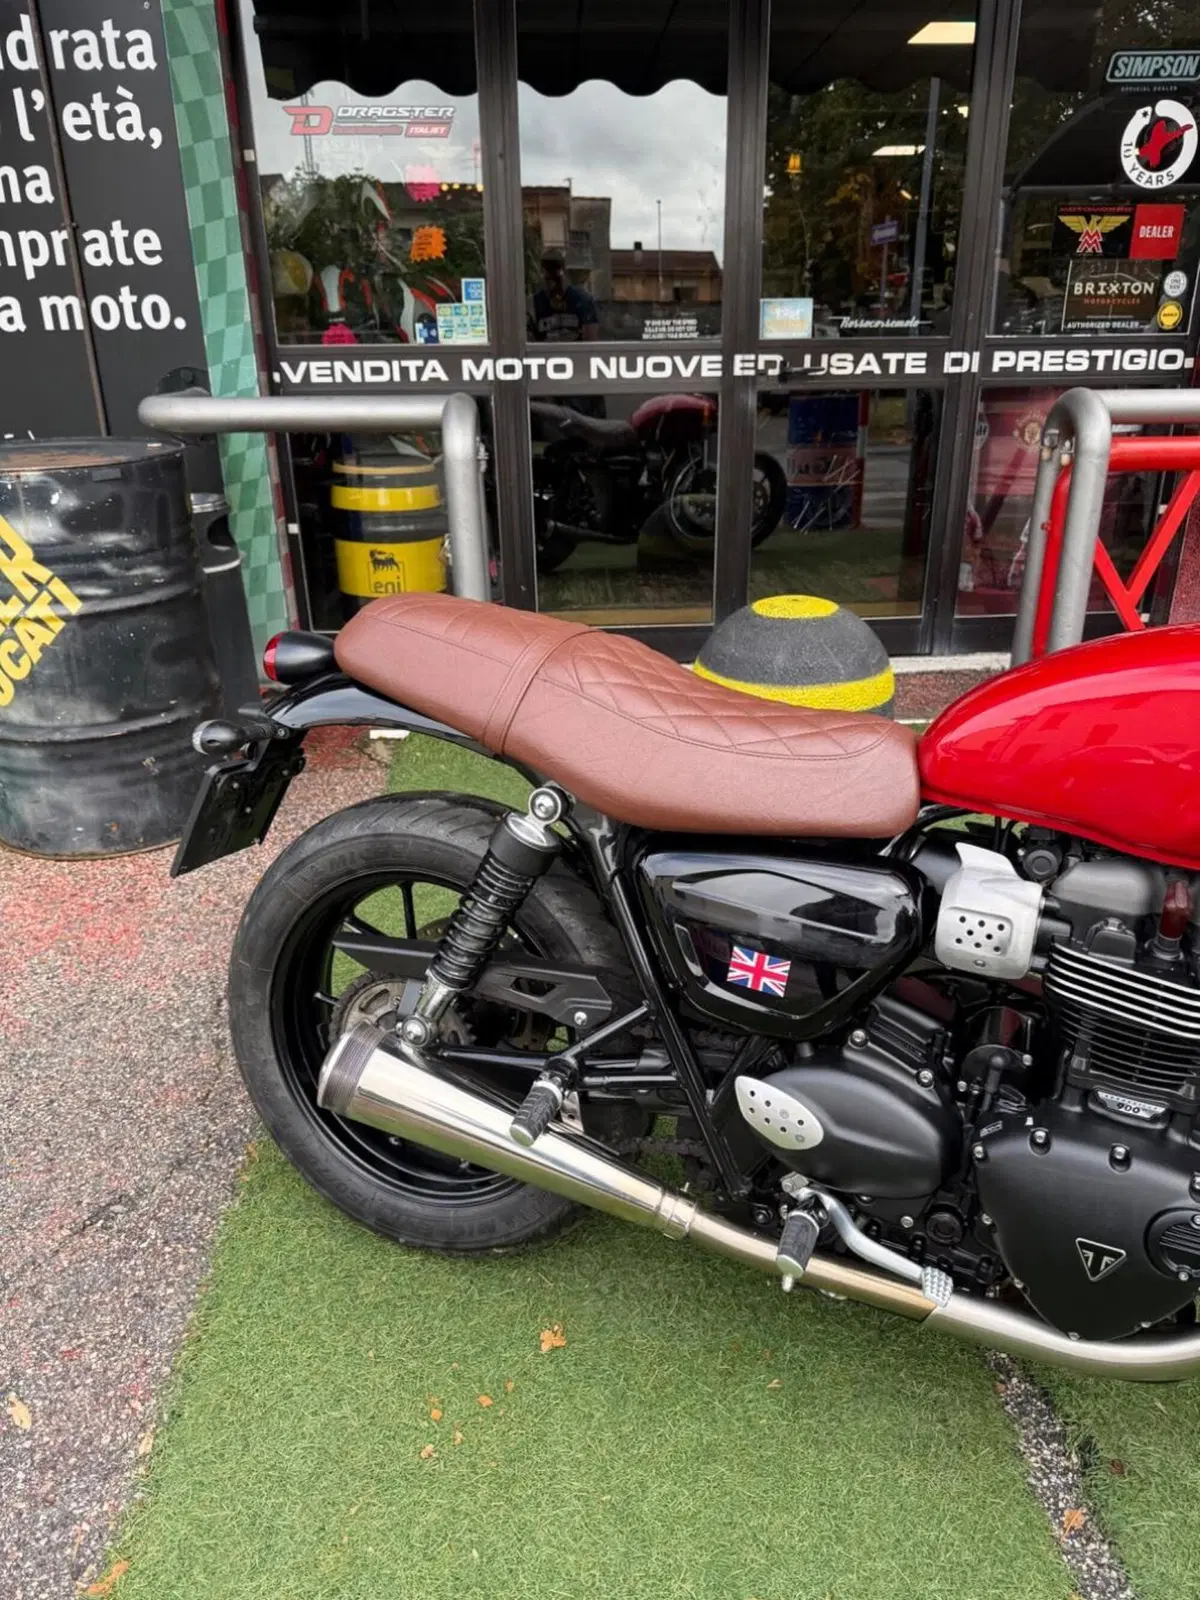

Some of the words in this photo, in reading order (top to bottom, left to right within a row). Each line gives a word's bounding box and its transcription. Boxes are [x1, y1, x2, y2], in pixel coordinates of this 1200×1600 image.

[0, 13, 158, 71] drata
[1113, 55, 1200, 78] SIMPSON
[337, 106, 456, 118] DRAGSTER
[1129, 162, 1174, 185] YEARS
[1139, 225, 1174, 238] DEALER
[1073, 281, 1155, 296] BRIXTON
[39, 285, 187, 331] moto.
[461, 357, 574, 381] MOTO
[589, 355, 723, 379] NUOVE
[733, 354, 784, 376] ED
[804, 352, 928, 376] USATE
[943, 351, 980, 374] DI
[373, 576, 401, 594] eni
[1117, 1102, 1140, 1113] 900
